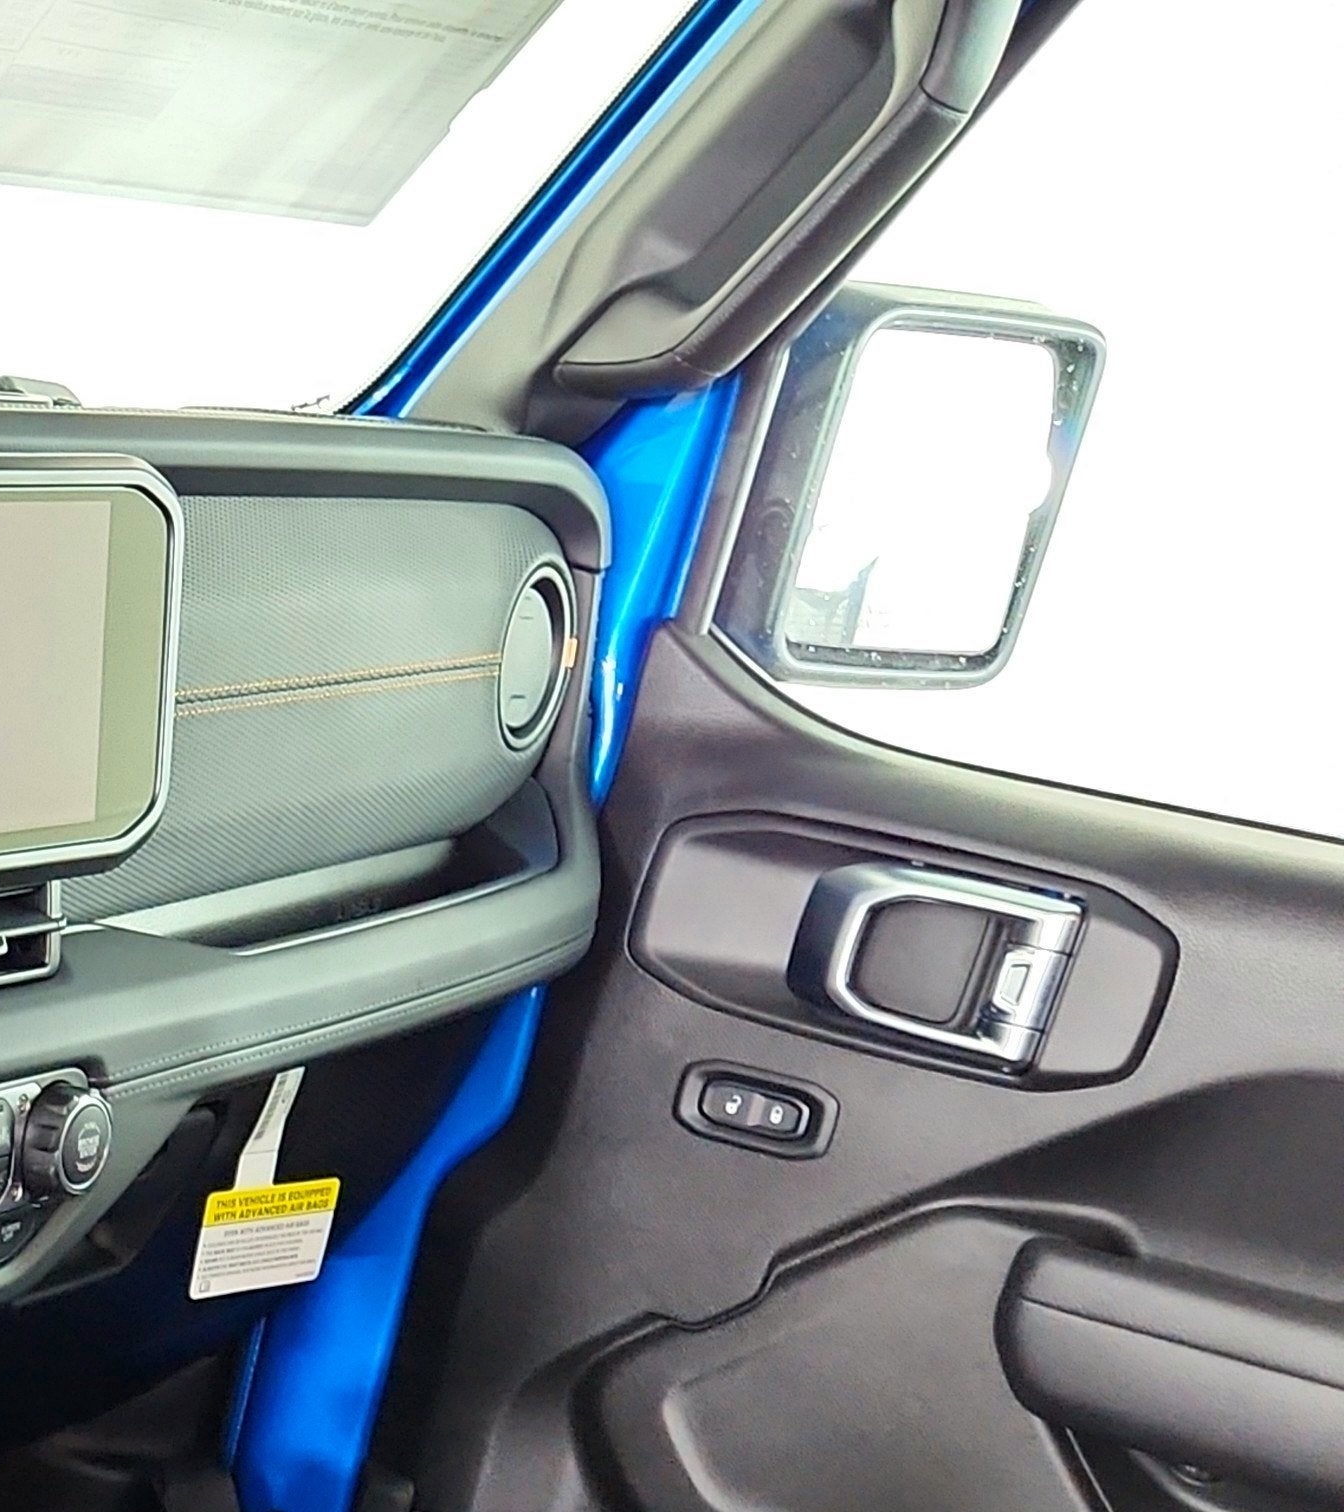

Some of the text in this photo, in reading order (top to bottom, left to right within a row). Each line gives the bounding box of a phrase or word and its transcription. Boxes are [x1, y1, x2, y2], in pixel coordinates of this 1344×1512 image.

[238, 1193, 275, 1207] VEHICLE
[213, 1210, 236, 1222] WITH
[238, 1204, 288, 1219] ADVANCED
